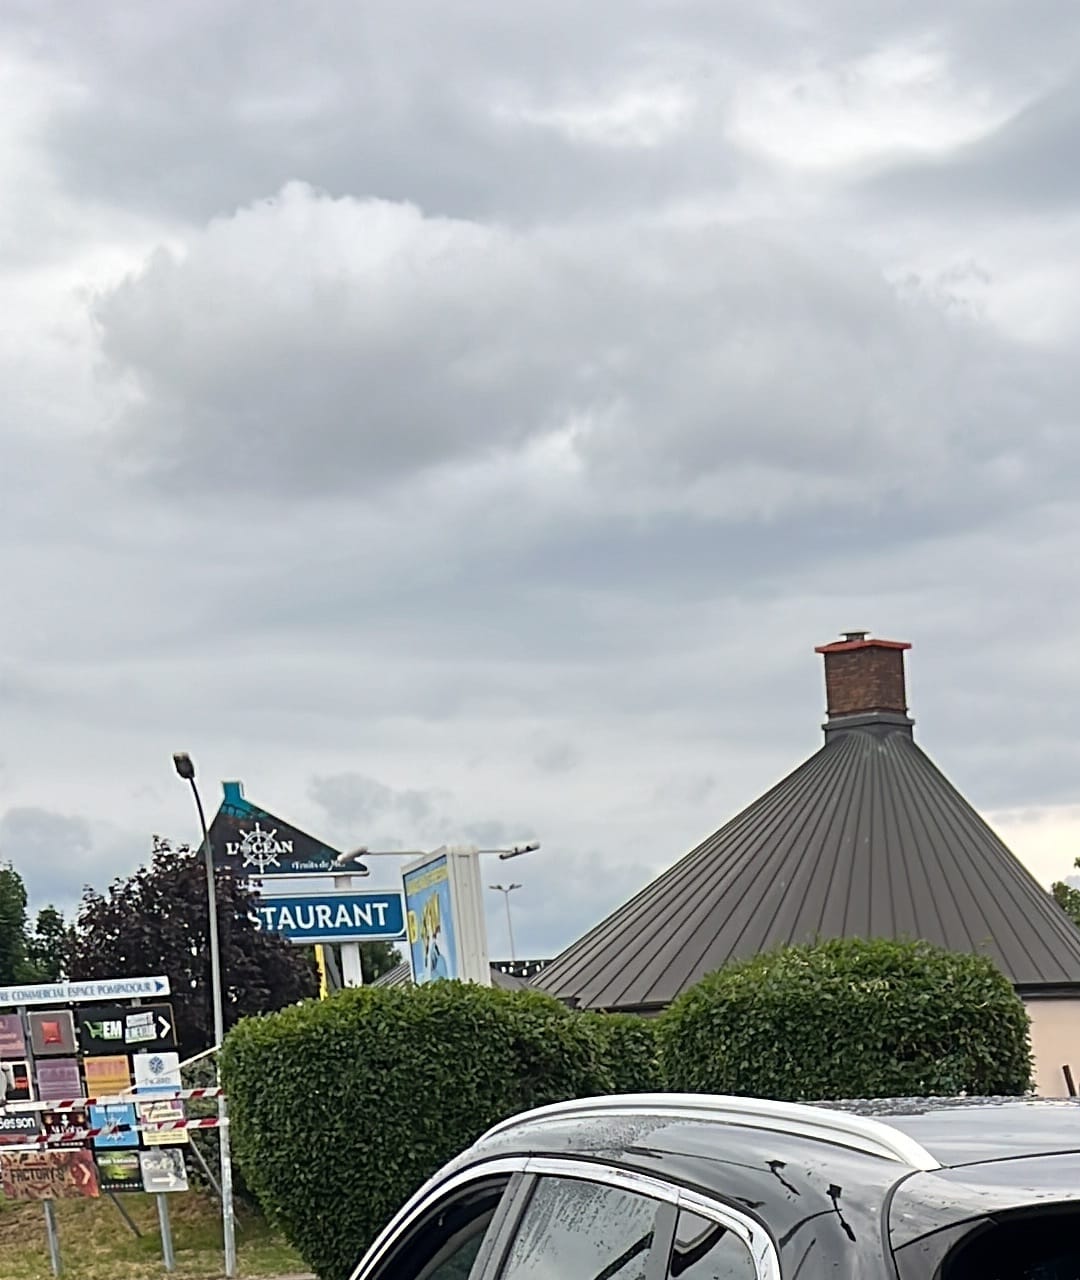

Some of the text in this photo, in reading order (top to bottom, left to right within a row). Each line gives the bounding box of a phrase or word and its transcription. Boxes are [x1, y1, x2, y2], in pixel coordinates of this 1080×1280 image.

[247, 902, 389, 931] STAURANT
[12, 987, 65, 1000] COMMERCIAL
[68, 985, 95, 997] ESPACE
[98, 982, 151, 995] POMPADOUR
